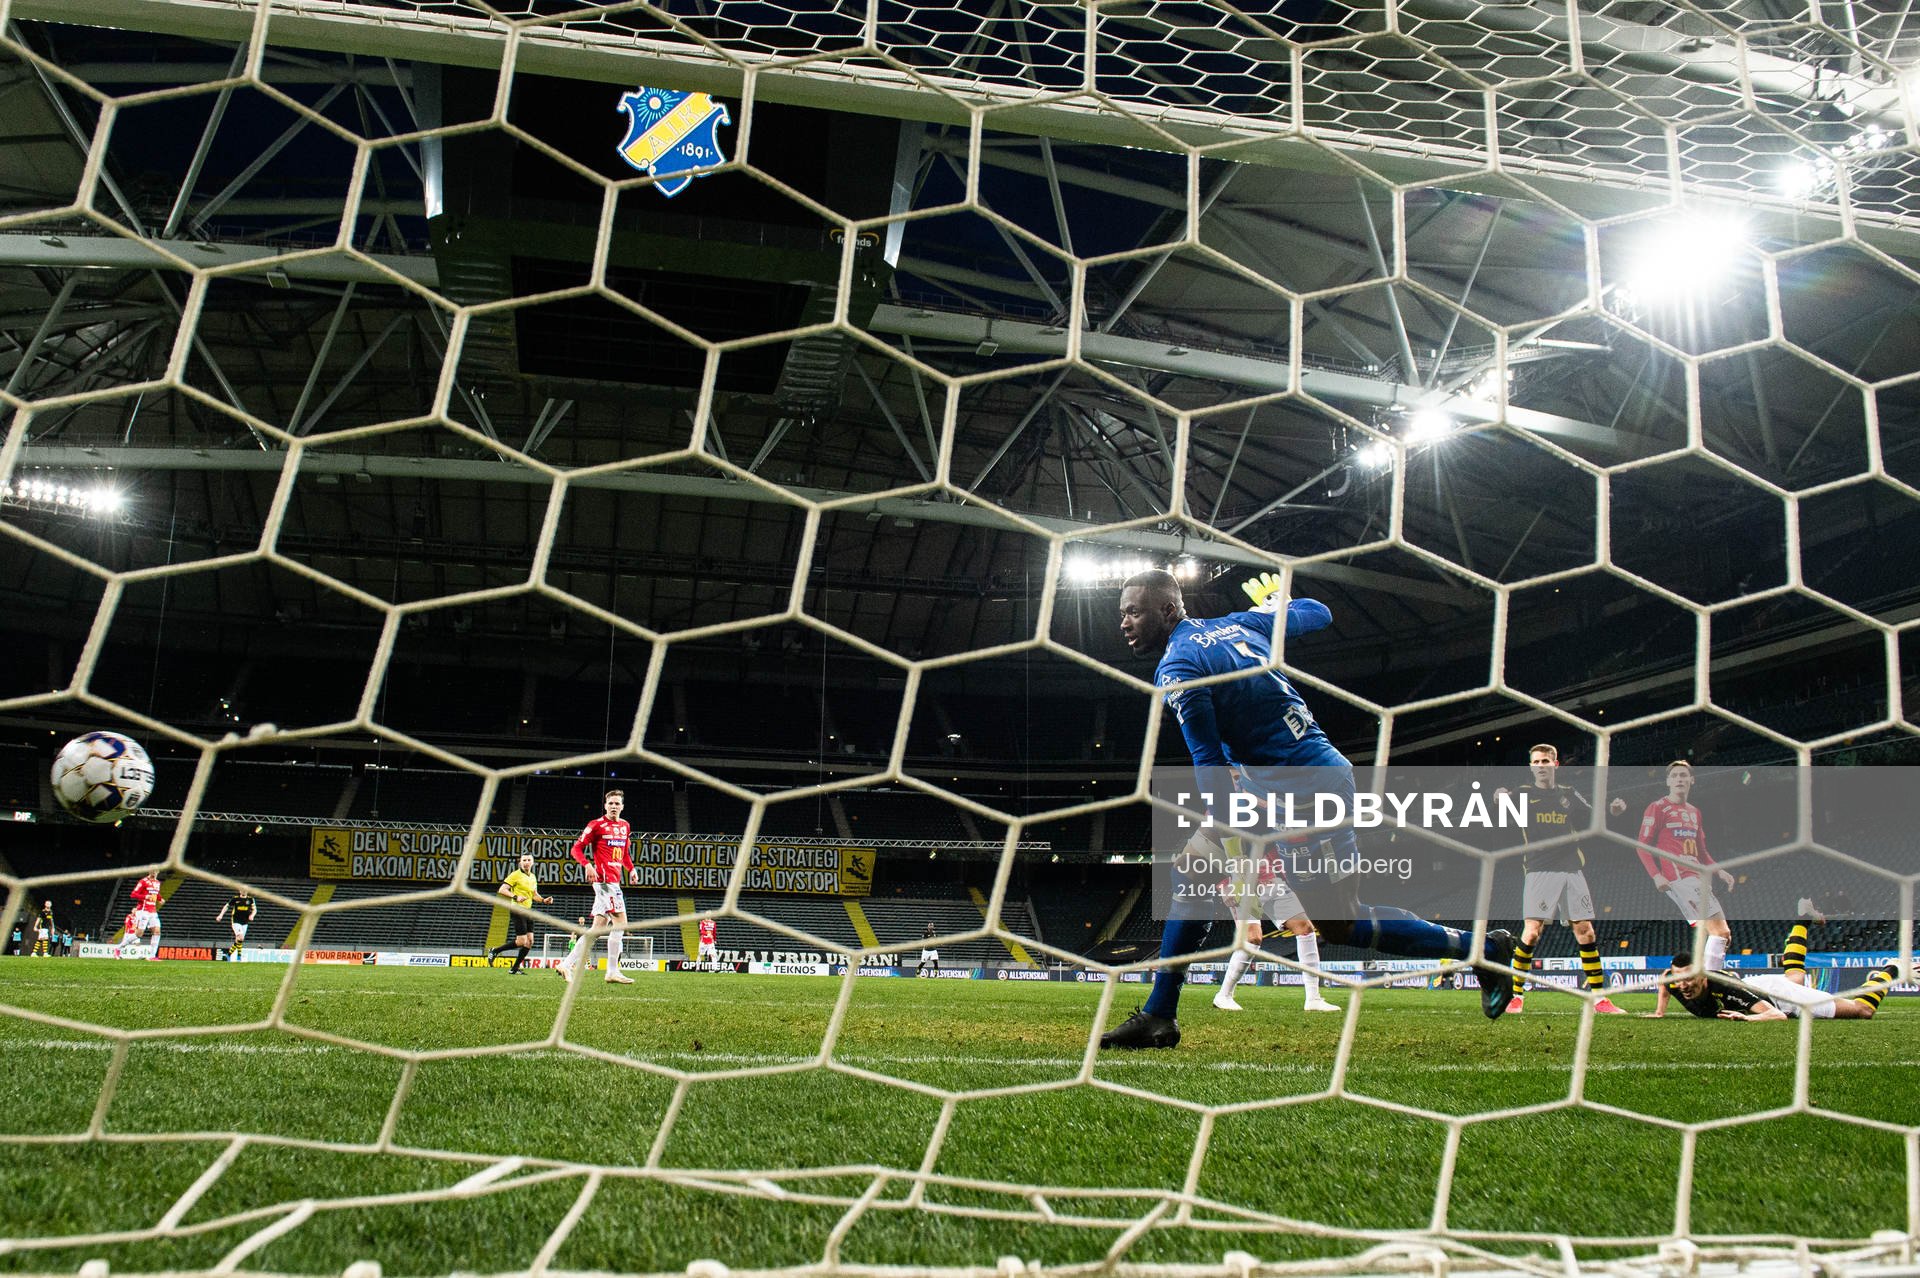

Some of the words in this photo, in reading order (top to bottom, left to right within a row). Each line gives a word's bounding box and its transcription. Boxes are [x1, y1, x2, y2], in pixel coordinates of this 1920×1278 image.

[837, 235, 872, 247] frnds
[14, 811, 32, 822] DIF
[1535, 811, 1568, 824] notar
[352, 831, 388, 853] DEN
[640, 840, 662, 863] ÄR
[664, 843, 714, 865] BLOTT
[716, 845, 738, 866] EN
[750, 846, 839, 869] R-STRATEGI
[352, 856, 413, 878] BAKOM
[416, 858, 493, 881] FASAEN
[494, 859, 560, 882] VÄTAR
[775, 870, 839, 892] DYSTOPI
[336, 951, 363, 961] BRAND
[409, 956, 448, 965] KATEPAL
[713, 949, 757, 963] VILA
[772, 952, 822, 965] FRID
[774, 965, 816, 974] TEKNOS
[1008, 971, 1049, 980] ALLSVENSKAN
